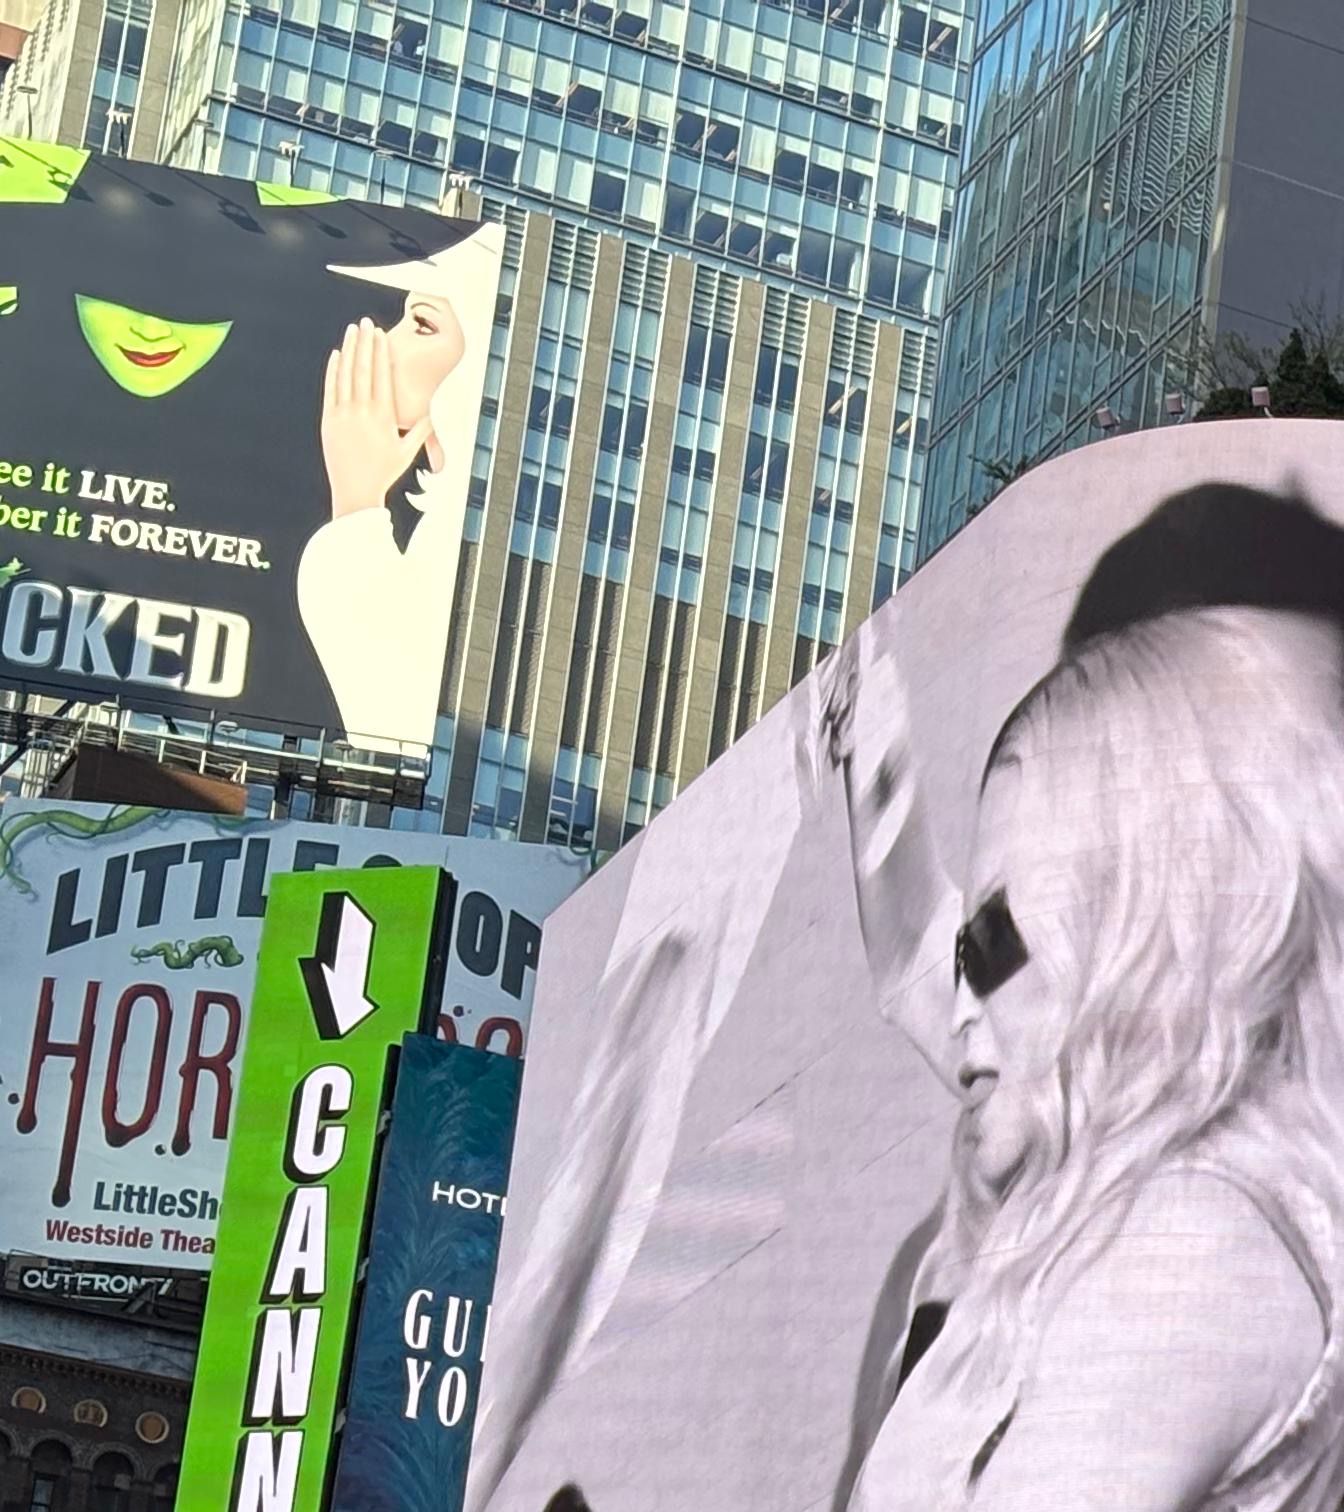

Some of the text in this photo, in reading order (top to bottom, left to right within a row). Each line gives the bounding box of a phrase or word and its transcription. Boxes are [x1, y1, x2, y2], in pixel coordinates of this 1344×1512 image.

[41, 462, 71, 494] it
[78, 469, 176, 512] LIVE.
[53, 506, 82, 538] it
[88, 513, 271, 570] FOREVER.
[2, 579, 251, 699] CKED
[93, 1181, 223, 1221] LittleSh
[46, 1219, 216, 1255] Westside Thea
[405, 1357, 467, 1427] YO
